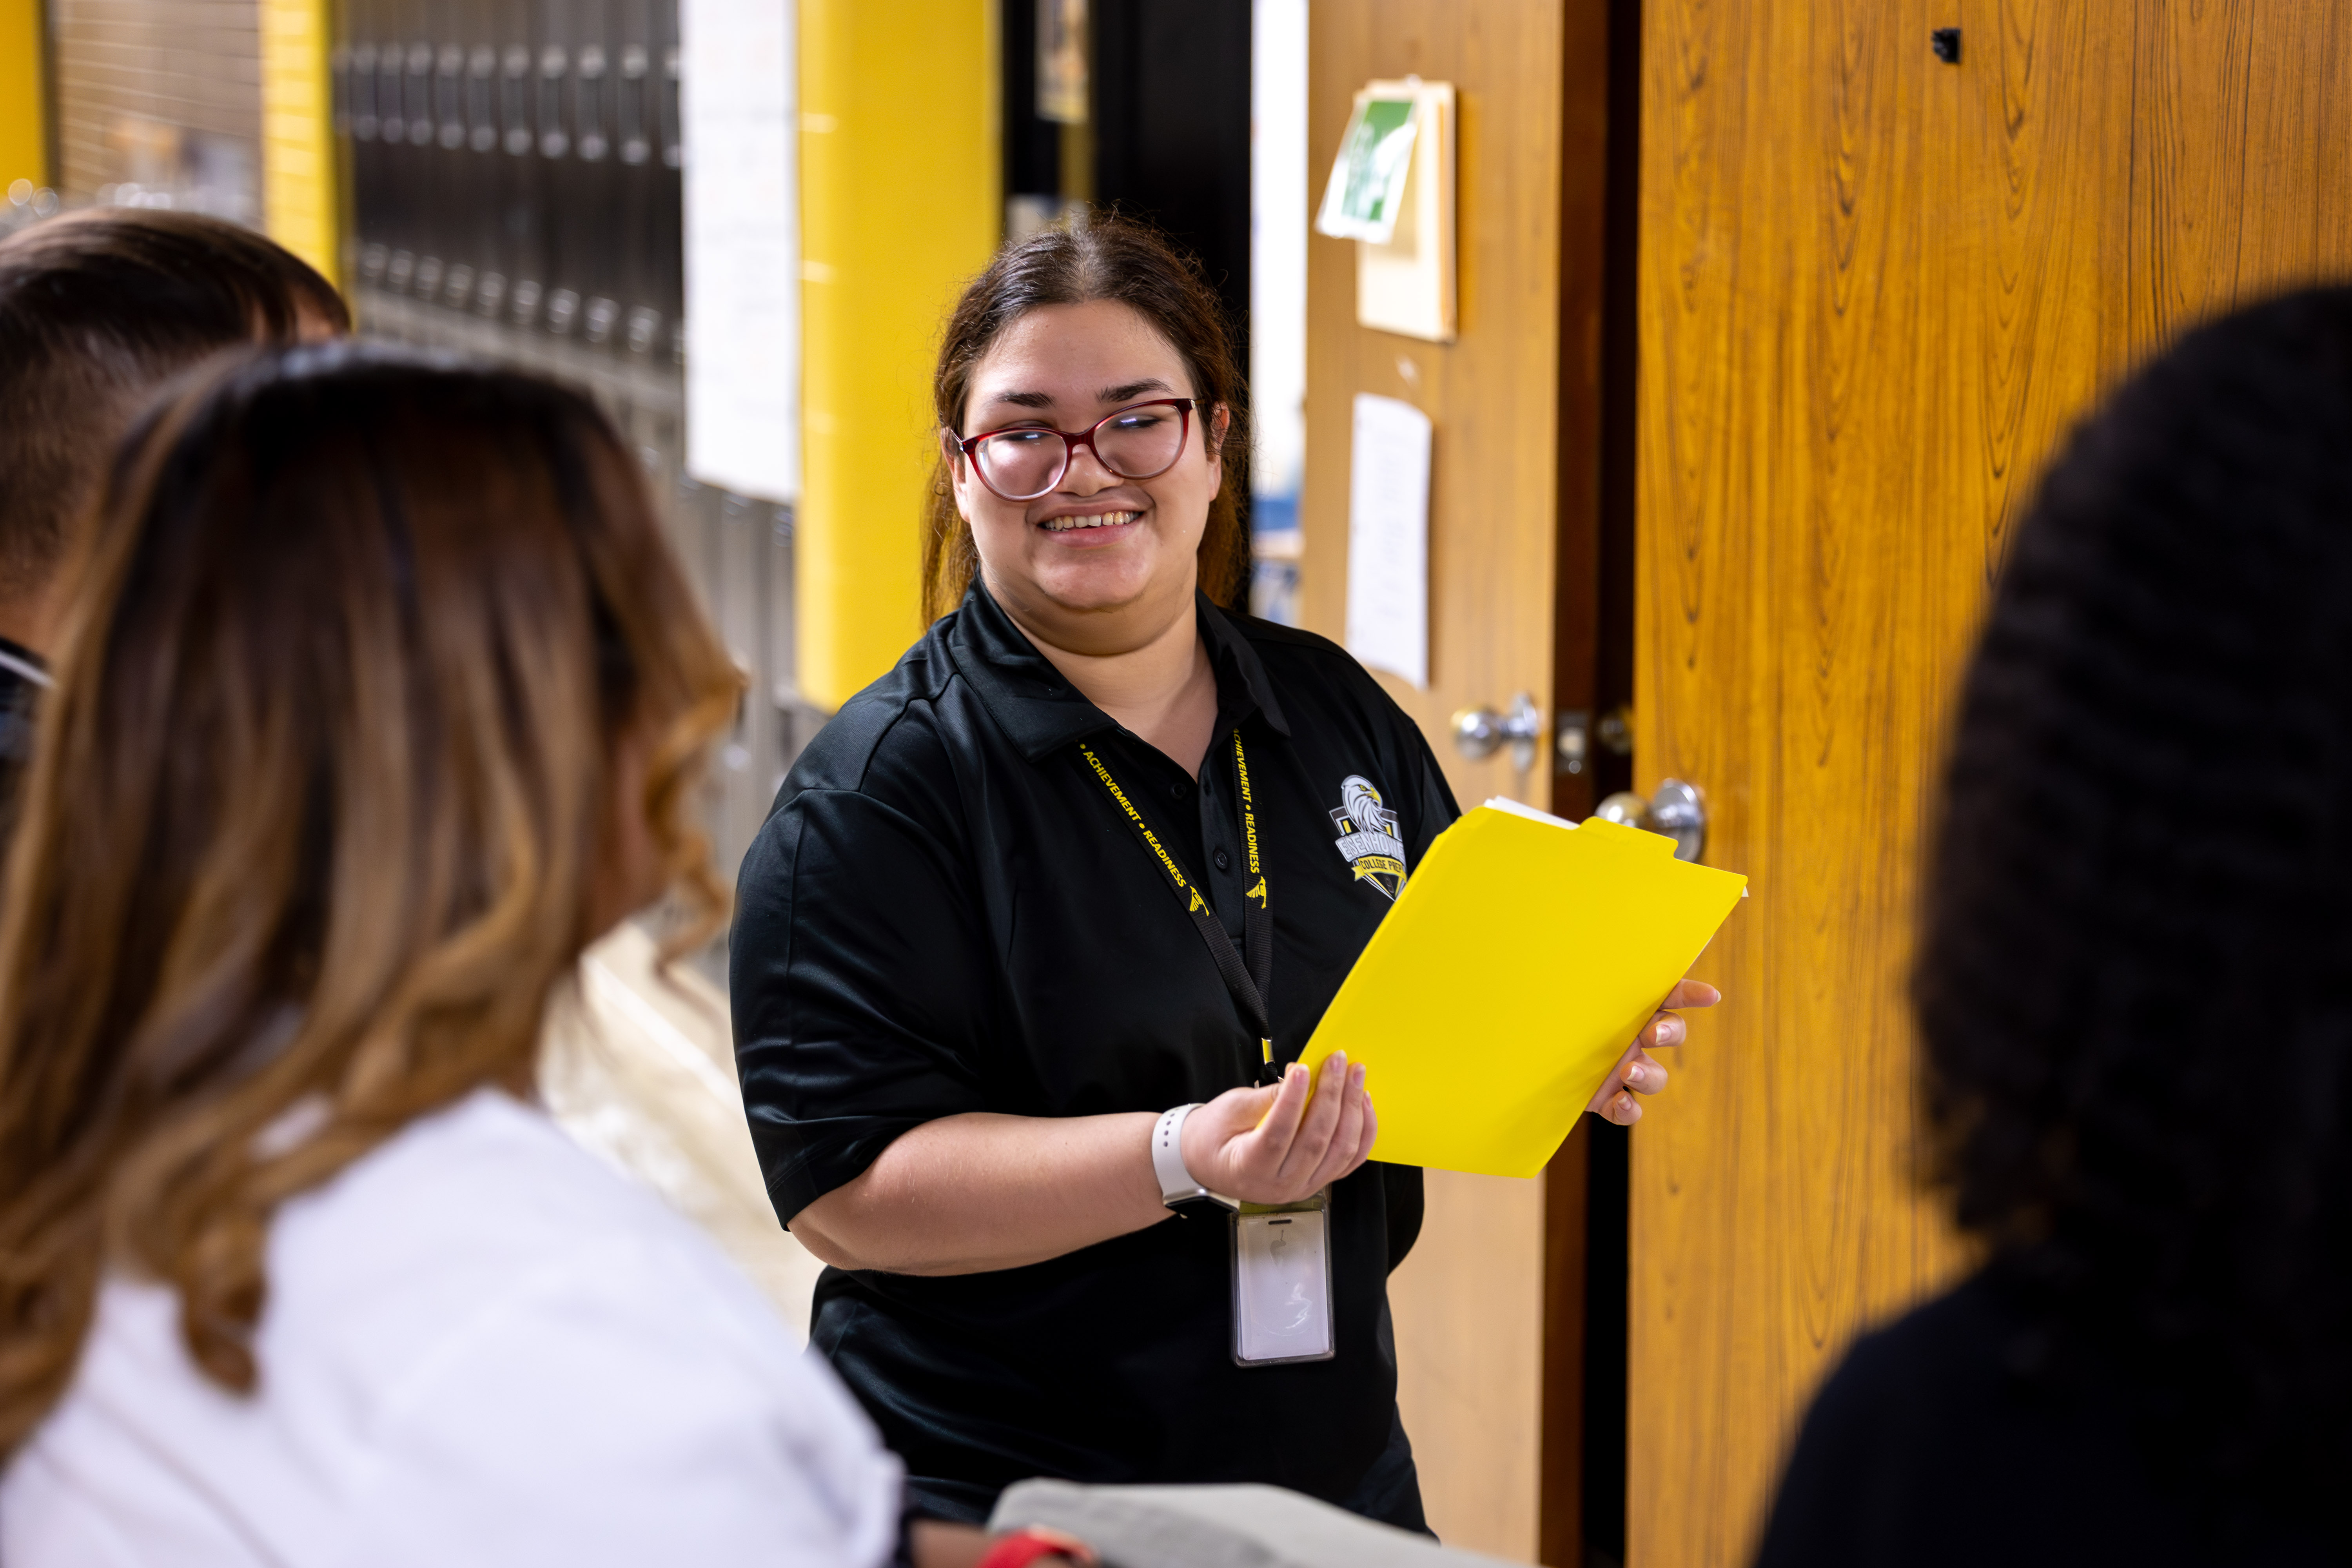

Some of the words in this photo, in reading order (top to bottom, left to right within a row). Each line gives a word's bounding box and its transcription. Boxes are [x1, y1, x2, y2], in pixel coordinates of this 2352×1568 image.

[1083, 751, 1142, 820] ACHIEVEMENT
[1143, 830, 1187, 887] READINESS
[1233, 728, 1252, 803] ACHIEVEMENT
[1245, 813, 1259, 873] READINESS
[1336, 833, 1405, 862] EISENHOWE
[1360, 859, 1388, 870] COLLEGE
